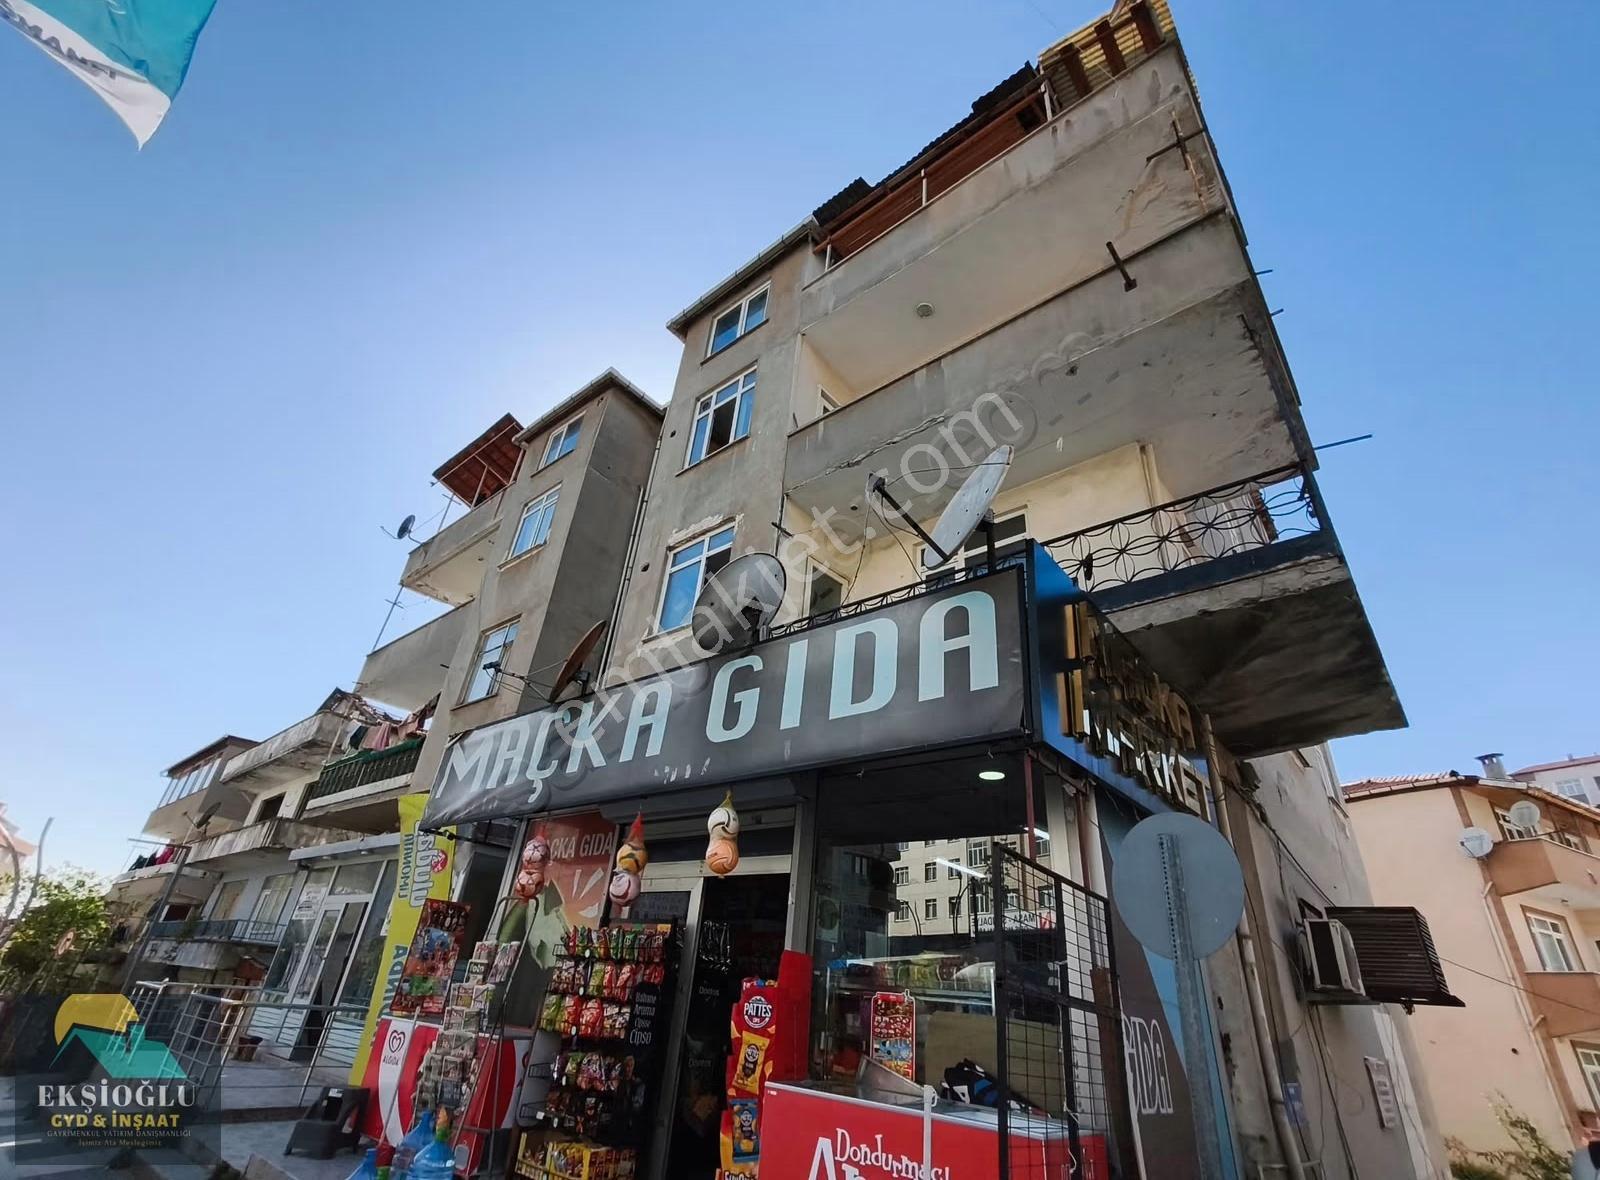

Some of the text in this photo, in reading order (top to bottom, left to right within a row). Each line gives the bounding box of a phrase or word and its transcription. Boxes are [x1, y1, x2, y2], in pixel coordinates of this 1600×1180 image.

[433, 681, 674, 804] MAÇKA
[705, 590, 1000, 744] GIDA
[579, 832, 614, 858] GIDA
[743, 1002, 772, 1018] PATTES
